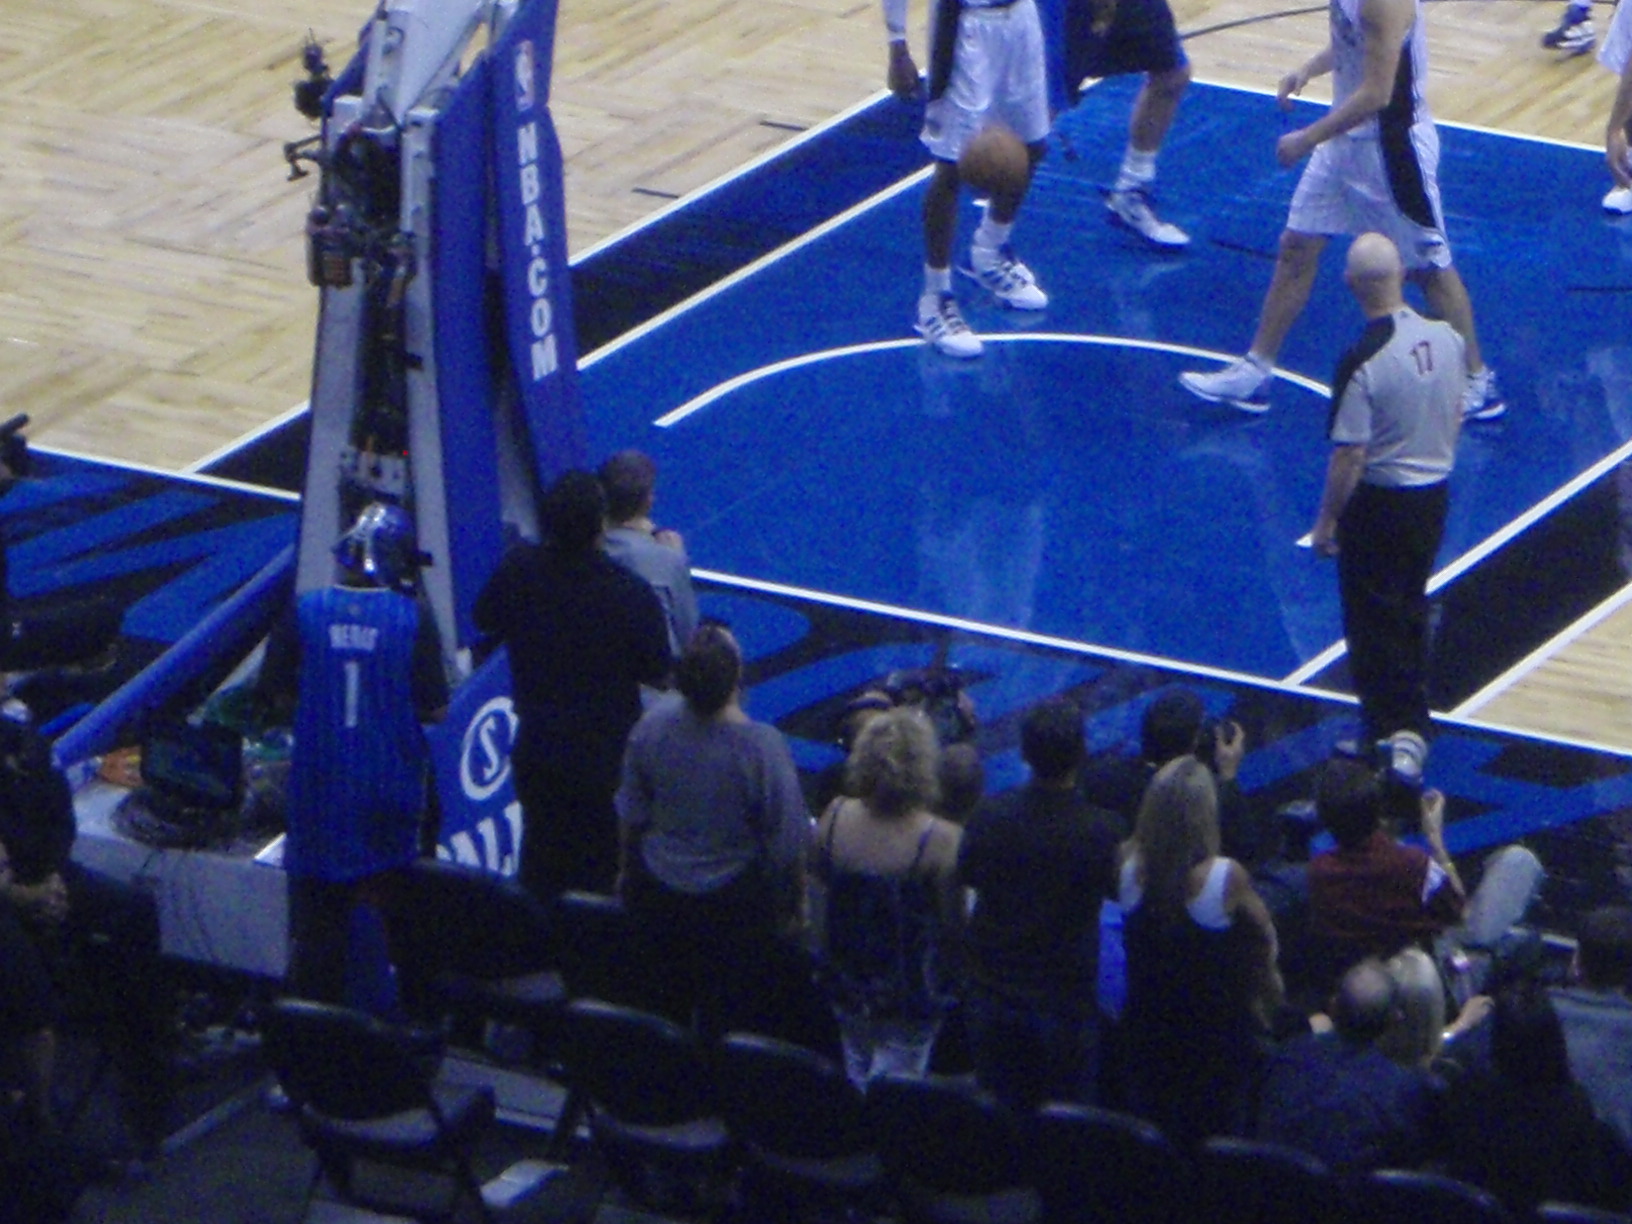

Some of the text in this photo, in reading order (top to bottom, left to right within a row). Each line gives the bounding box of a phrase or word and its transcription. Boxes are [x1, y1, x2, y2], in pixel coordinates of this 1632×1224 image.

[516, 121, 558, 382] NBA.COM
[1409, 340, 1433, 376] 17
[344, 660, 360, 729] 1
